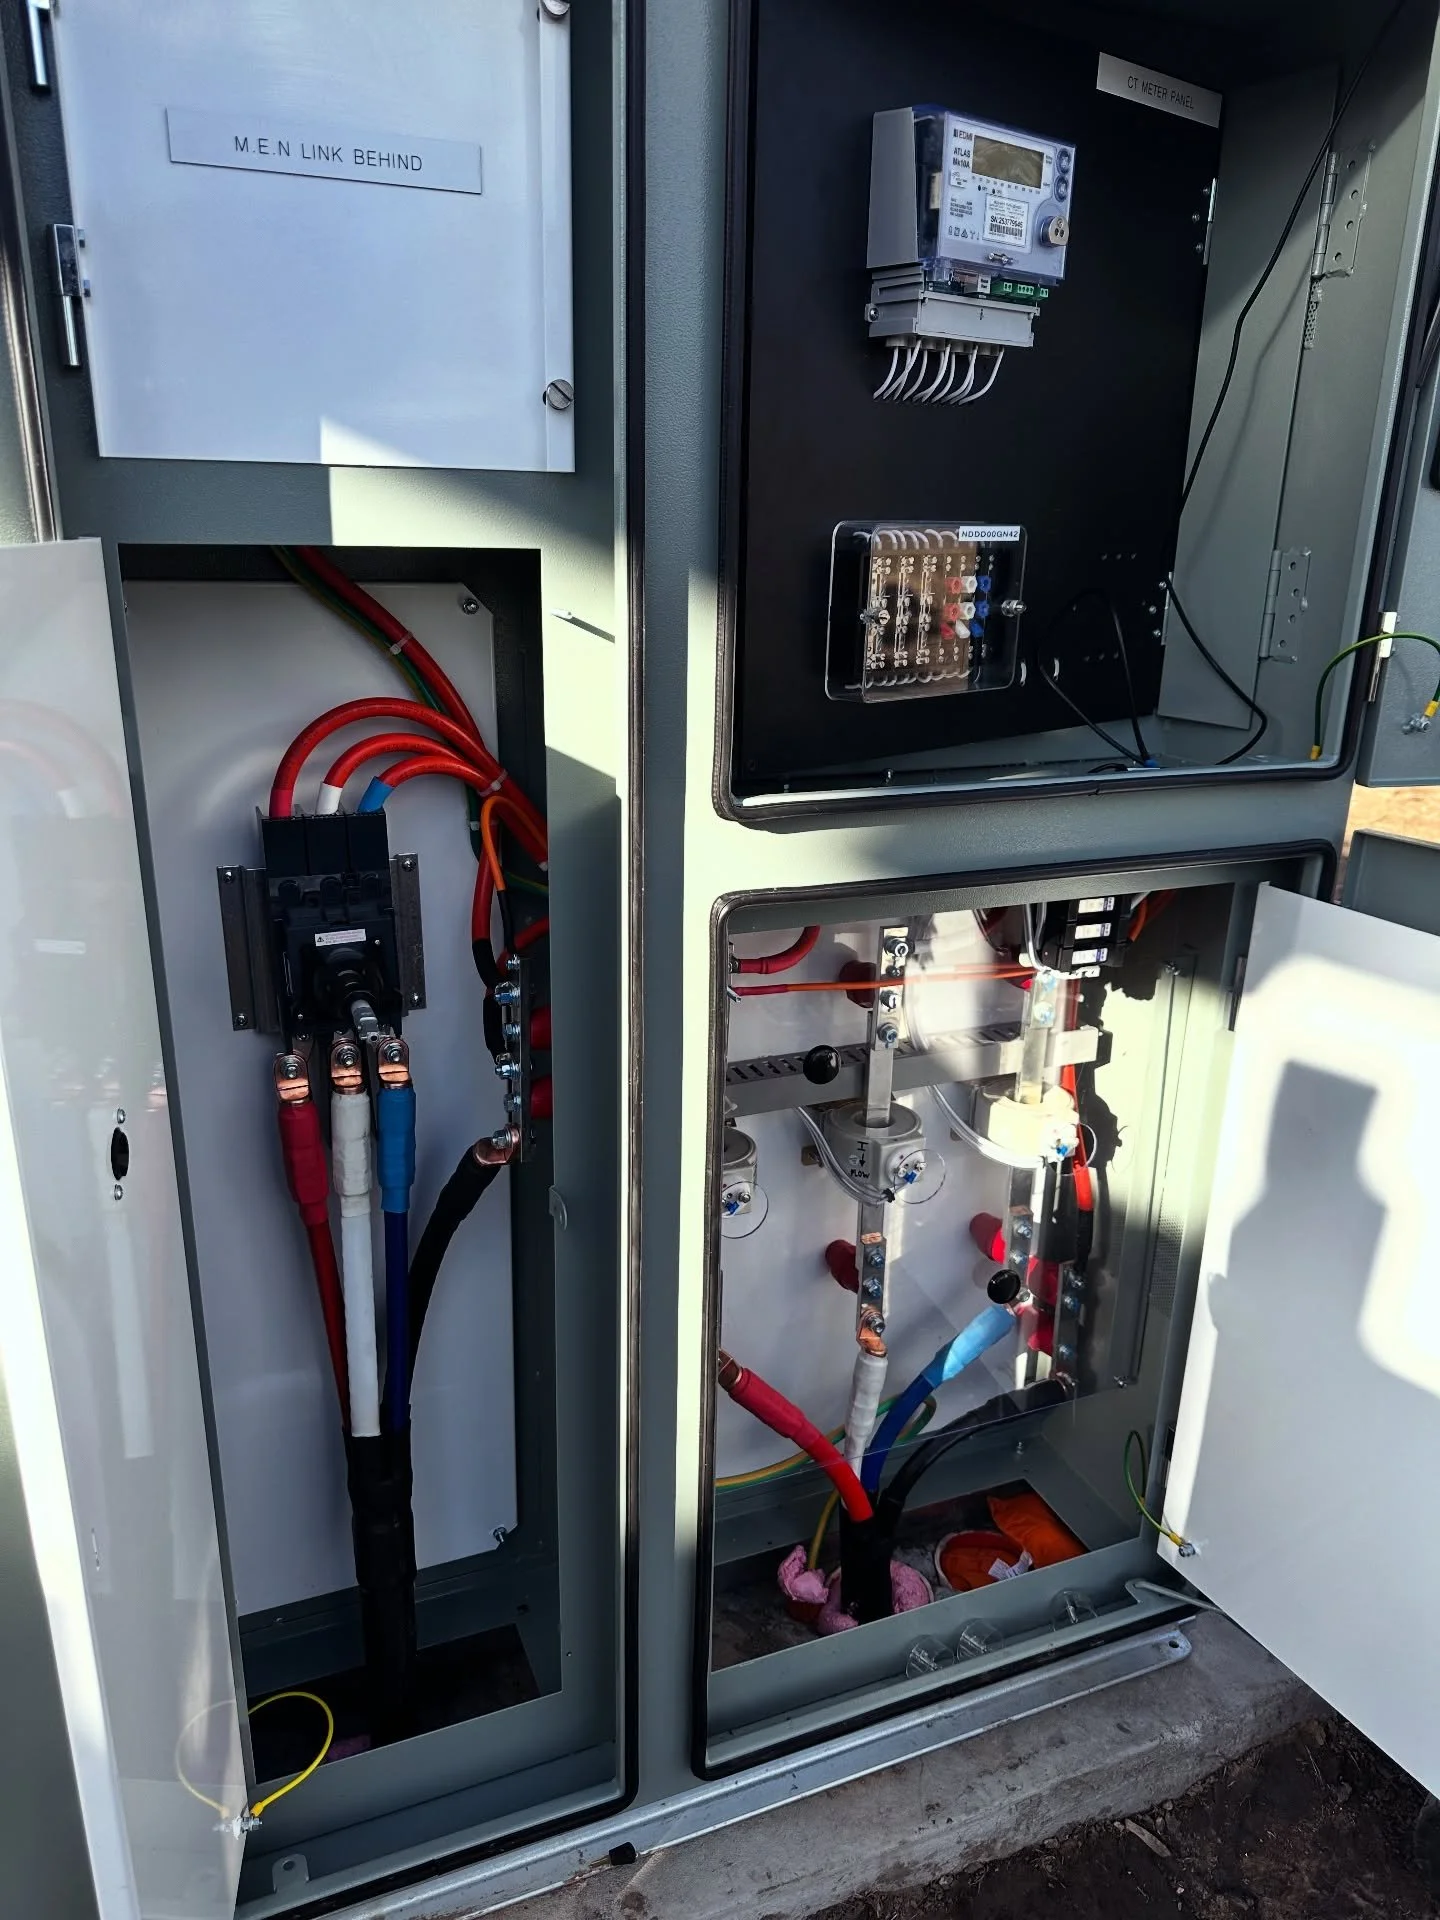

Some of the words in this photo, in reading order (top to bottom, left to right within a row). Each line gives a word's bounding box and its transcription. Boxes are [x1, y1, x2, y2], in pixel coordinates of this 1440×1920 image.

[1127, 75, 1139, 90] CT
[1141, 80, 1168, 100] METER
[1170, 90, 1194, 110] PANEL
[234, 135, 290, 157] M.E.N
[301, 143, 344, 163] LINK
[353, 148, 423, 171] BEHIND
[953, 147, 971, 158] ATLAS
[850, 1168, 870, 1179] FLOW
